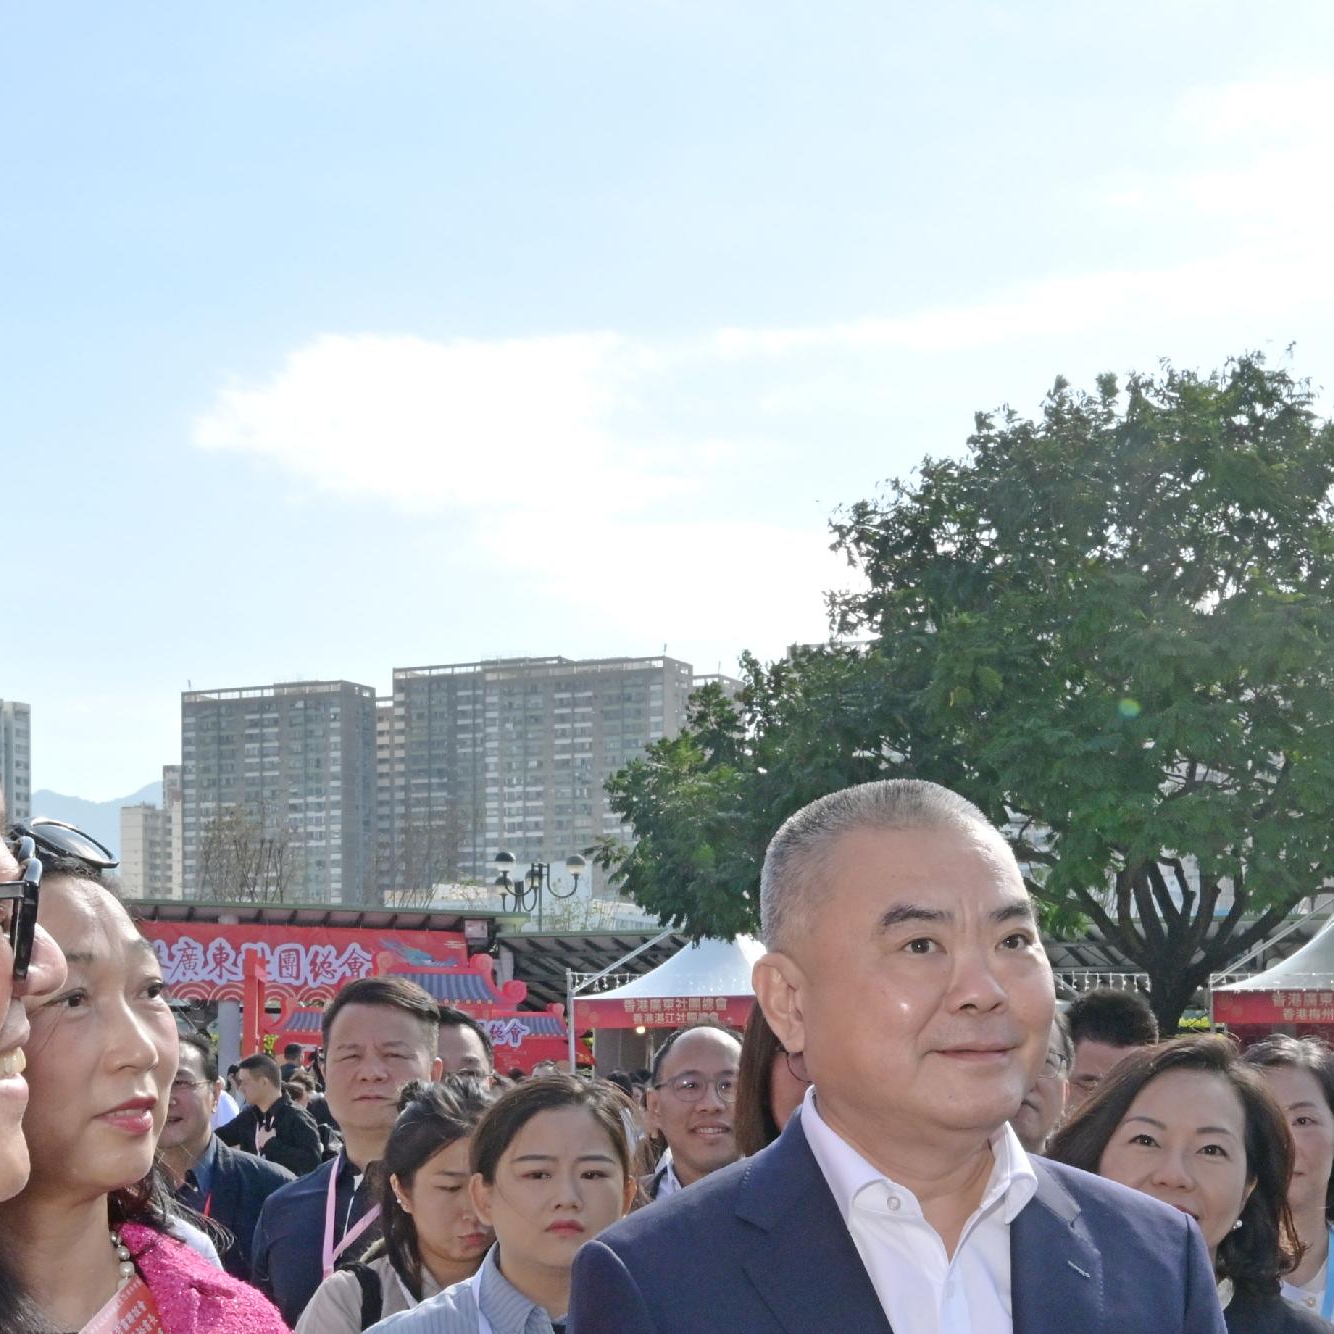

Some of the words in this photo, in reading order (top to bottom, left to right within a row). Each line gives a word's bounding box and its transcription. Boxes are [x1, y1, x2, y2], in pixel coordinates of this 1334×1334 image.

[624, 998, 727, 1012] 香港廣東社團總會
